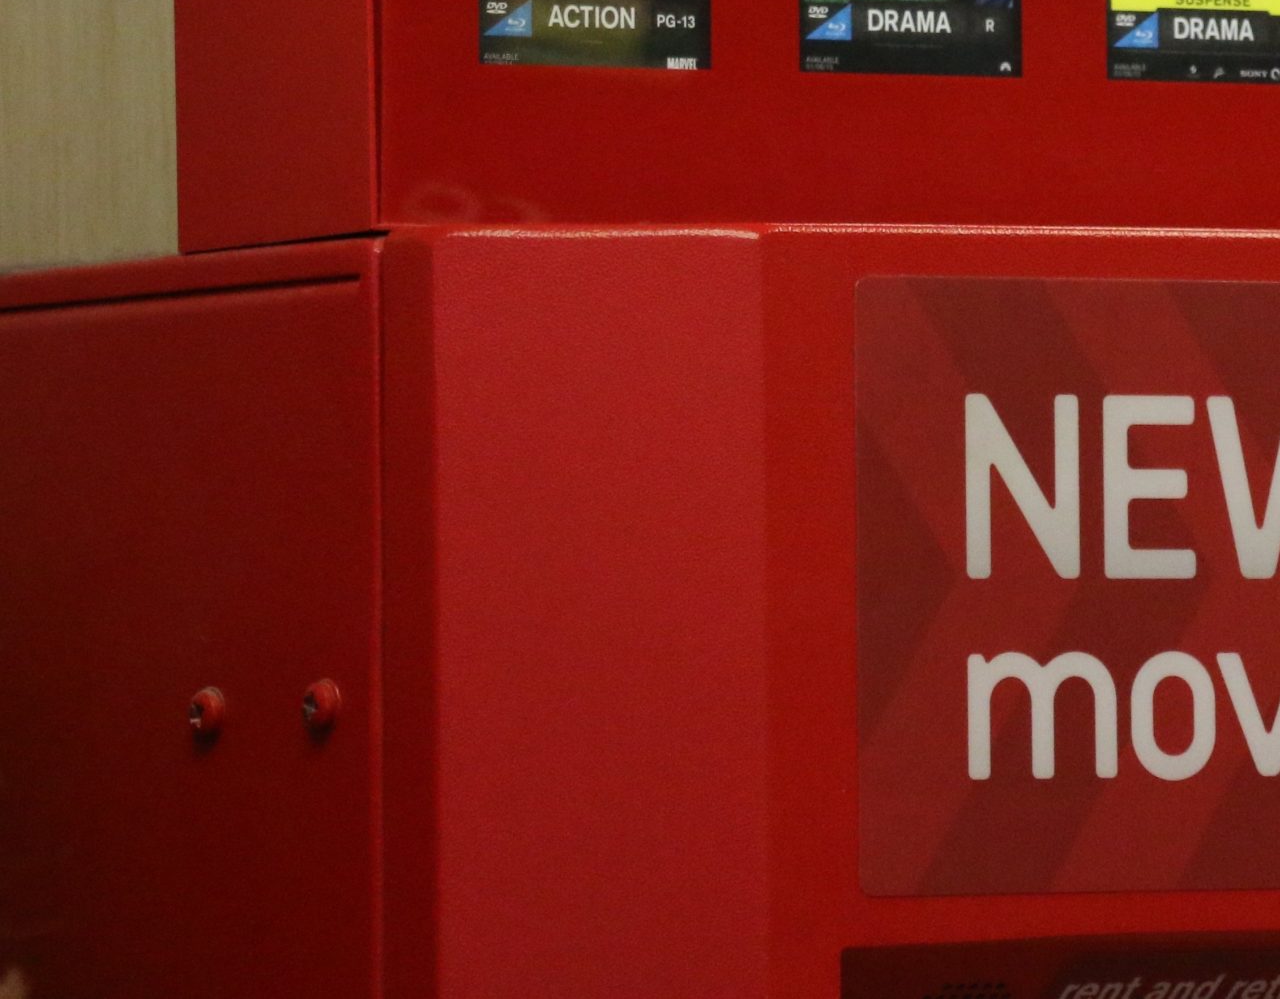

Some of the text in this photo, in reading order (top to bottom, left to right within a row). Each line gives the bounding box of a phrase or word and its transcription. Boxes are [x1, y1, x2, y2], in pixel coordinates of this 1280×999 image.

[486, 1, 508, 12] DVD
[808, 5, 829, 17] DVD
[548, 4, 636, 29] ACTION
[656, 14, 696, 28] PG-13
[867, 8, 951, 33] DRAMA
[985, 18, 995, 32] R
[1173, 17, 1254, 41] DRAMA
[1059, 977, 1142, 999] rent
[1145, 974, 1226, 999] and
